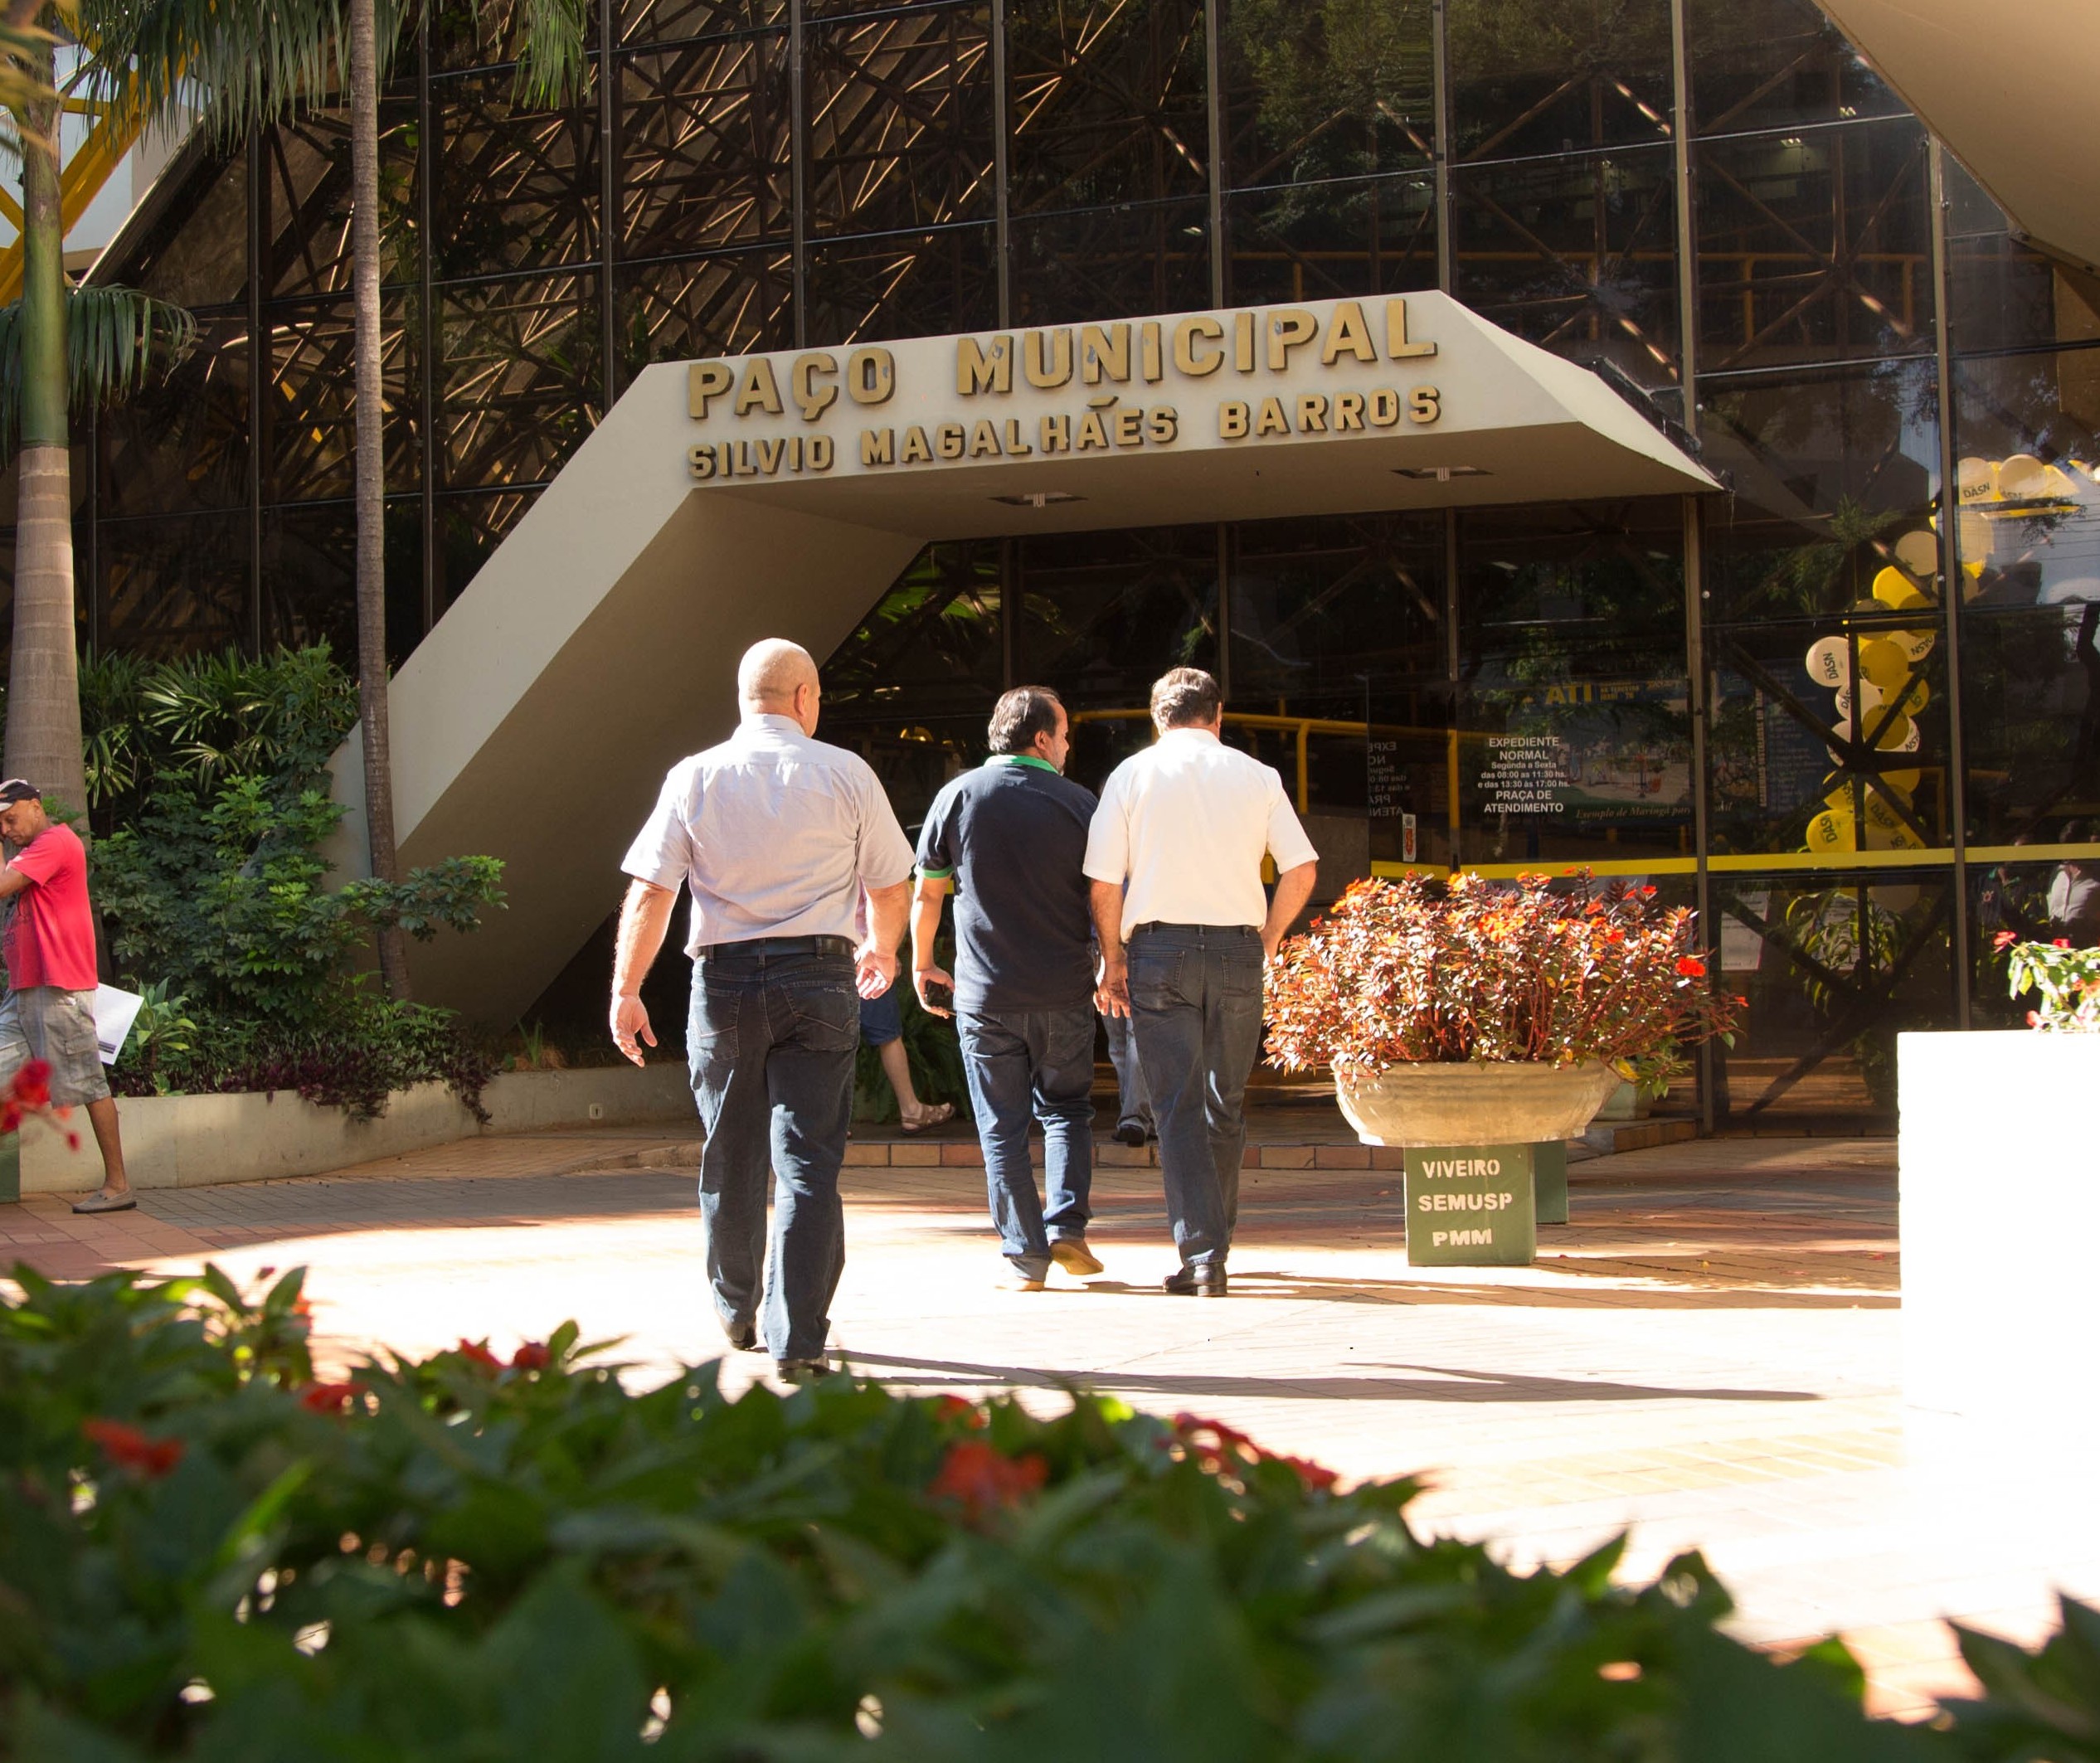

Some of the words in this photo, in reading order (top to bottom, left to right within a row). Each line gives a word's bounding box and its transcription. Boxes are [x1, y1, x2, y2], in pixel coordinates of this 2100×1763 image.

[688, 347, 896, 421] PAÇO
[956, 299, 1438, 396] MUNICIPAL
[688, 435, 834, 478] SILVIO
[1219, 385, 1441, 439] BARROS
[1545, 682, 1592, 705] ATI
[1489, 736, 1559, 747] EXPEDIENTE
[1500, 750, 1549, 760] NORMAL
[1491, 761, 1526, 770] Segunda
[1496, 790, 1534, 802] PRAÇA
[1537, 790, 1552, 799] DE
[1484, 803, 1563, 813] ATENDIMENTO
[1576, 808, 1614, 820] Exemplo
[1616, 807, 1627, 817] de
[1422, 1159, 1500, 1178] VIVEIRO
[1418, 1192, 1512, 1212] SEMUSP
[1432, 1228, 1492, 1246] PMM
